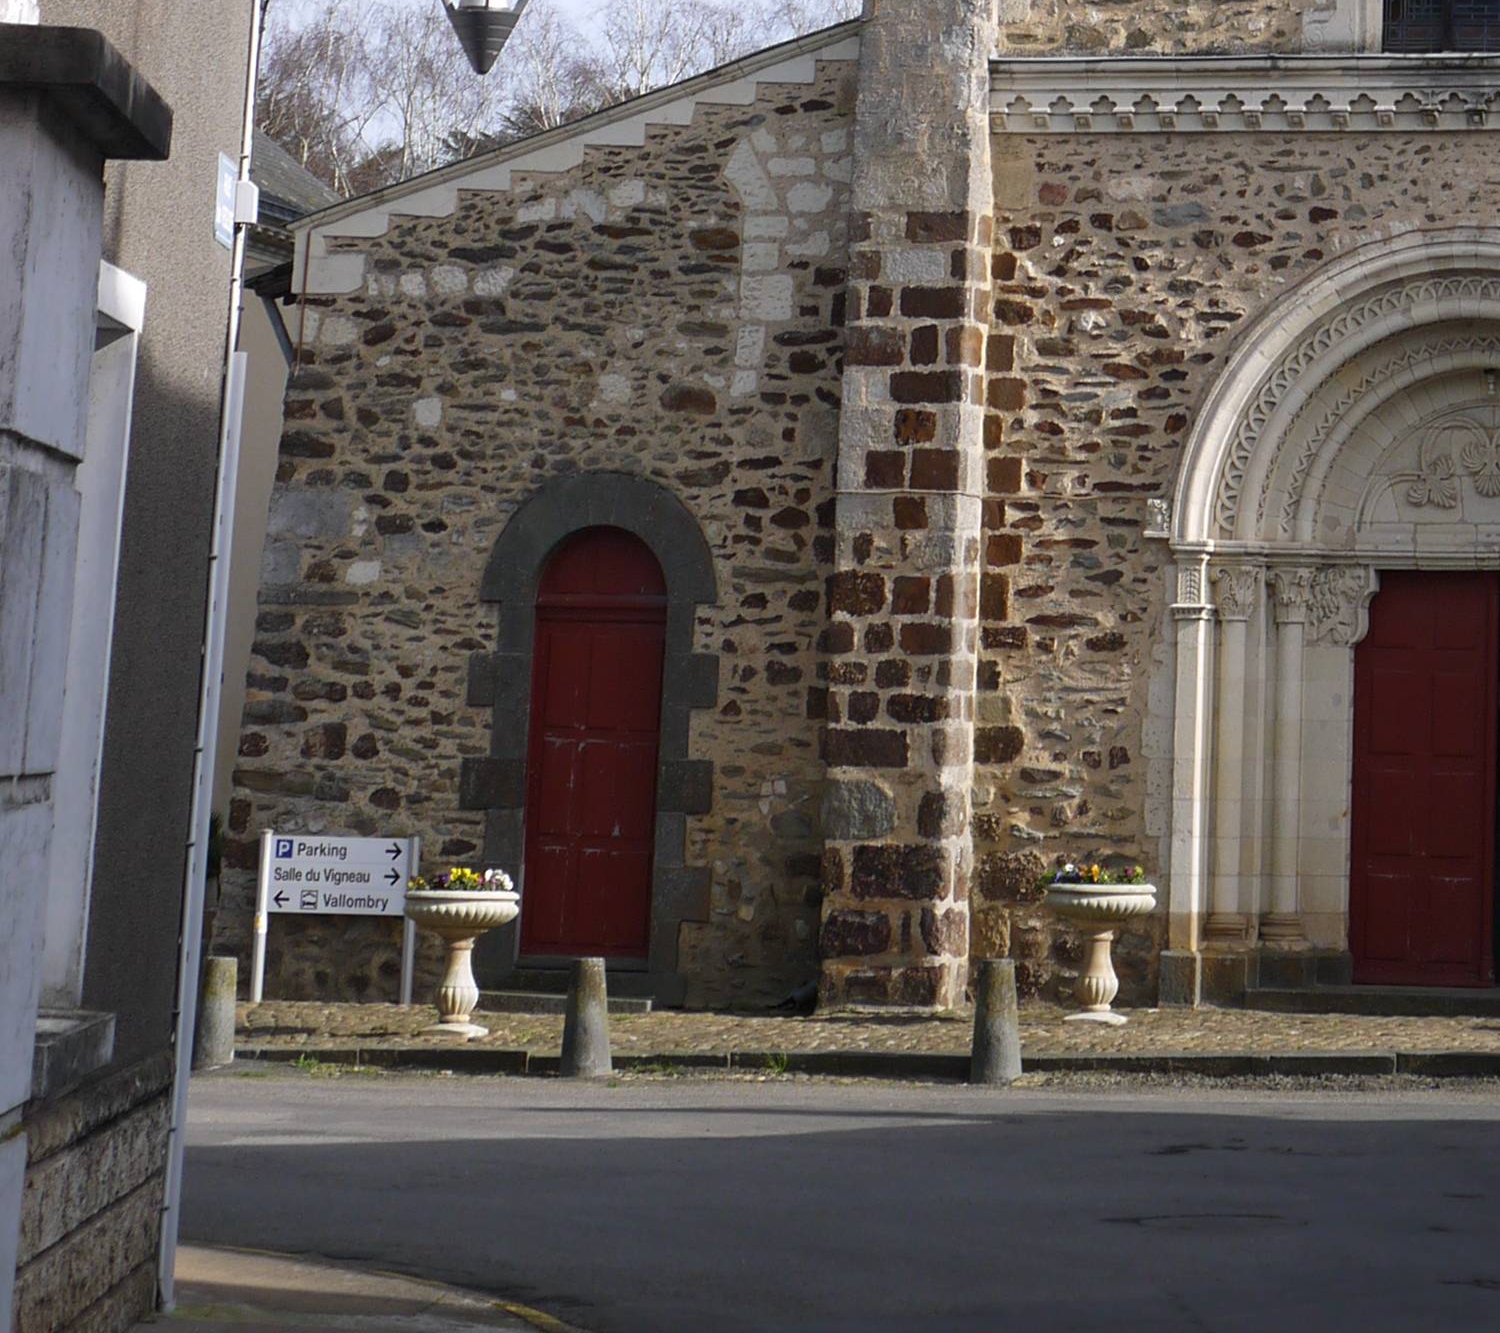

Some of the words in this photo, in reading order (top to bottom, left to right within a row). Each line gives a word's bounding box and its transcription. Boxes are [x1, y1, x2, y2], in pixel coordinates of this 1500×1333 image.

[297, 842, 348, 860] Parking
[274, 867, 302, 882] Salle
[305, 868, 320, 883] du
[323, 868, 371, 885] Vigneau
[323, 893, 388, 912] Vallombry
